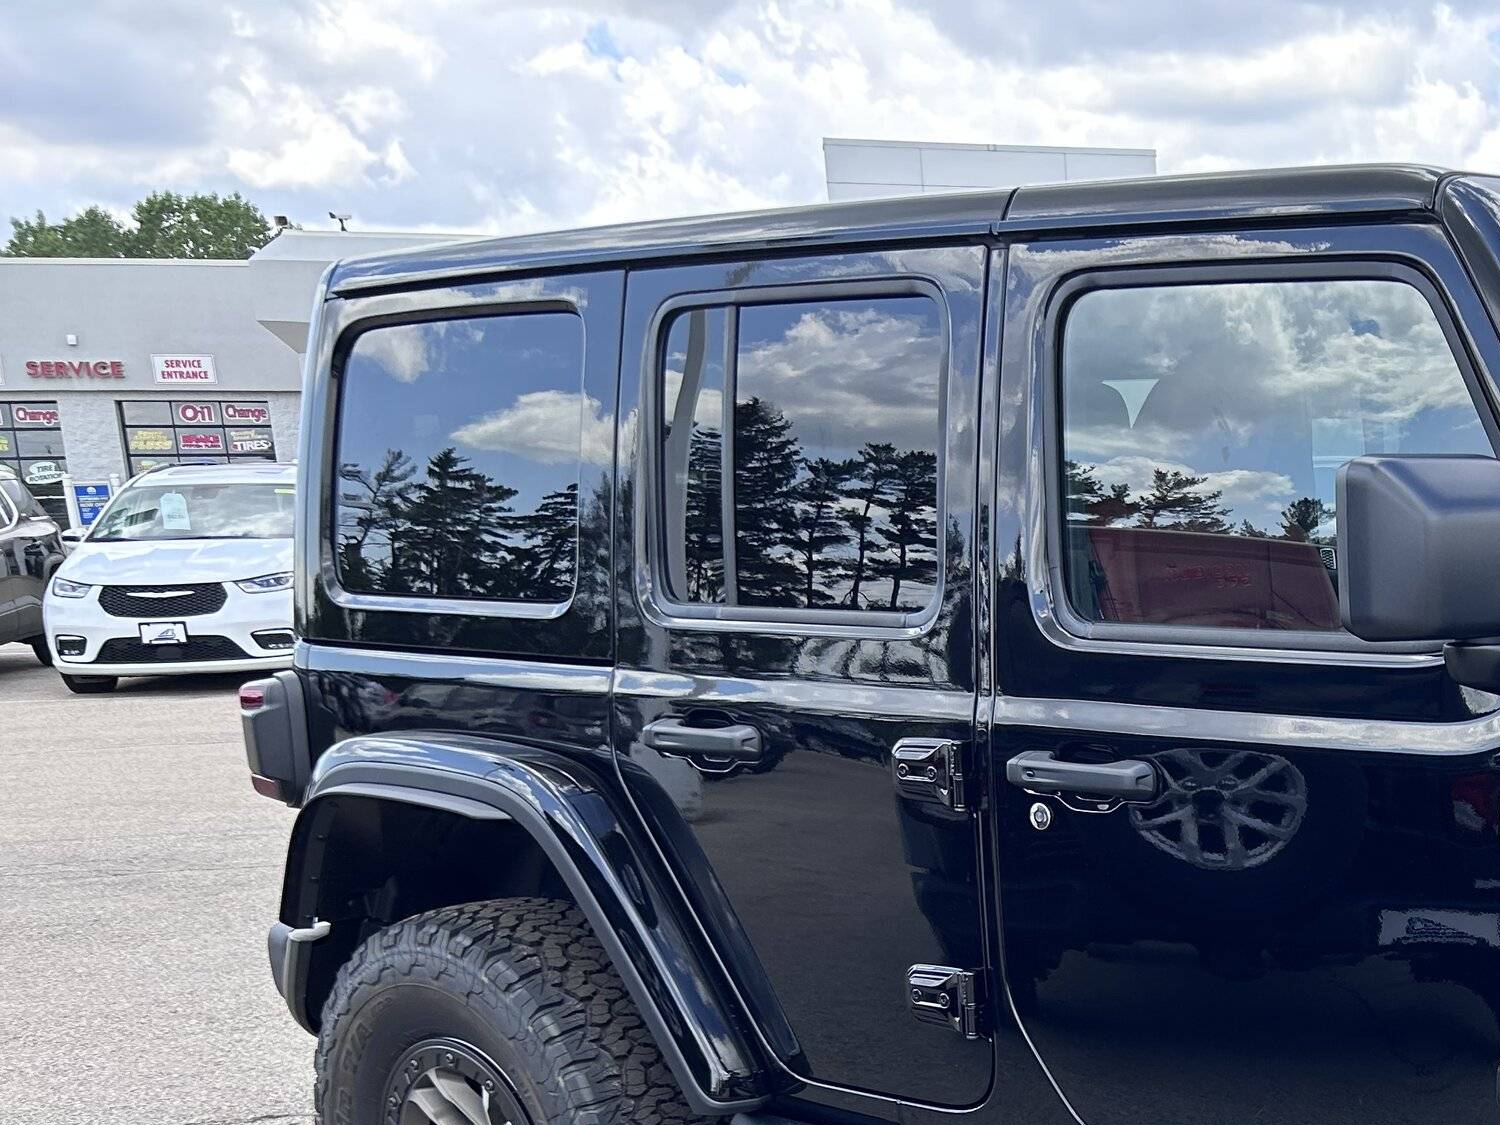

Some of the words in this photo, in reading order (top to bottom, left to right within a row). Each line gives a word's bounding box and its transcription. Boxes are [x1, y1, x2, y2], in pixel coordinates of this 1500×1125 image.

[26, 361, 125, 379] SERVICE
[164, 360, 202, 369] SERVICE
[161, 370, 209, 380] ENTRANCE
[224, 404, 267, 422] Change
[236, 440, 269, 451] TIRES
